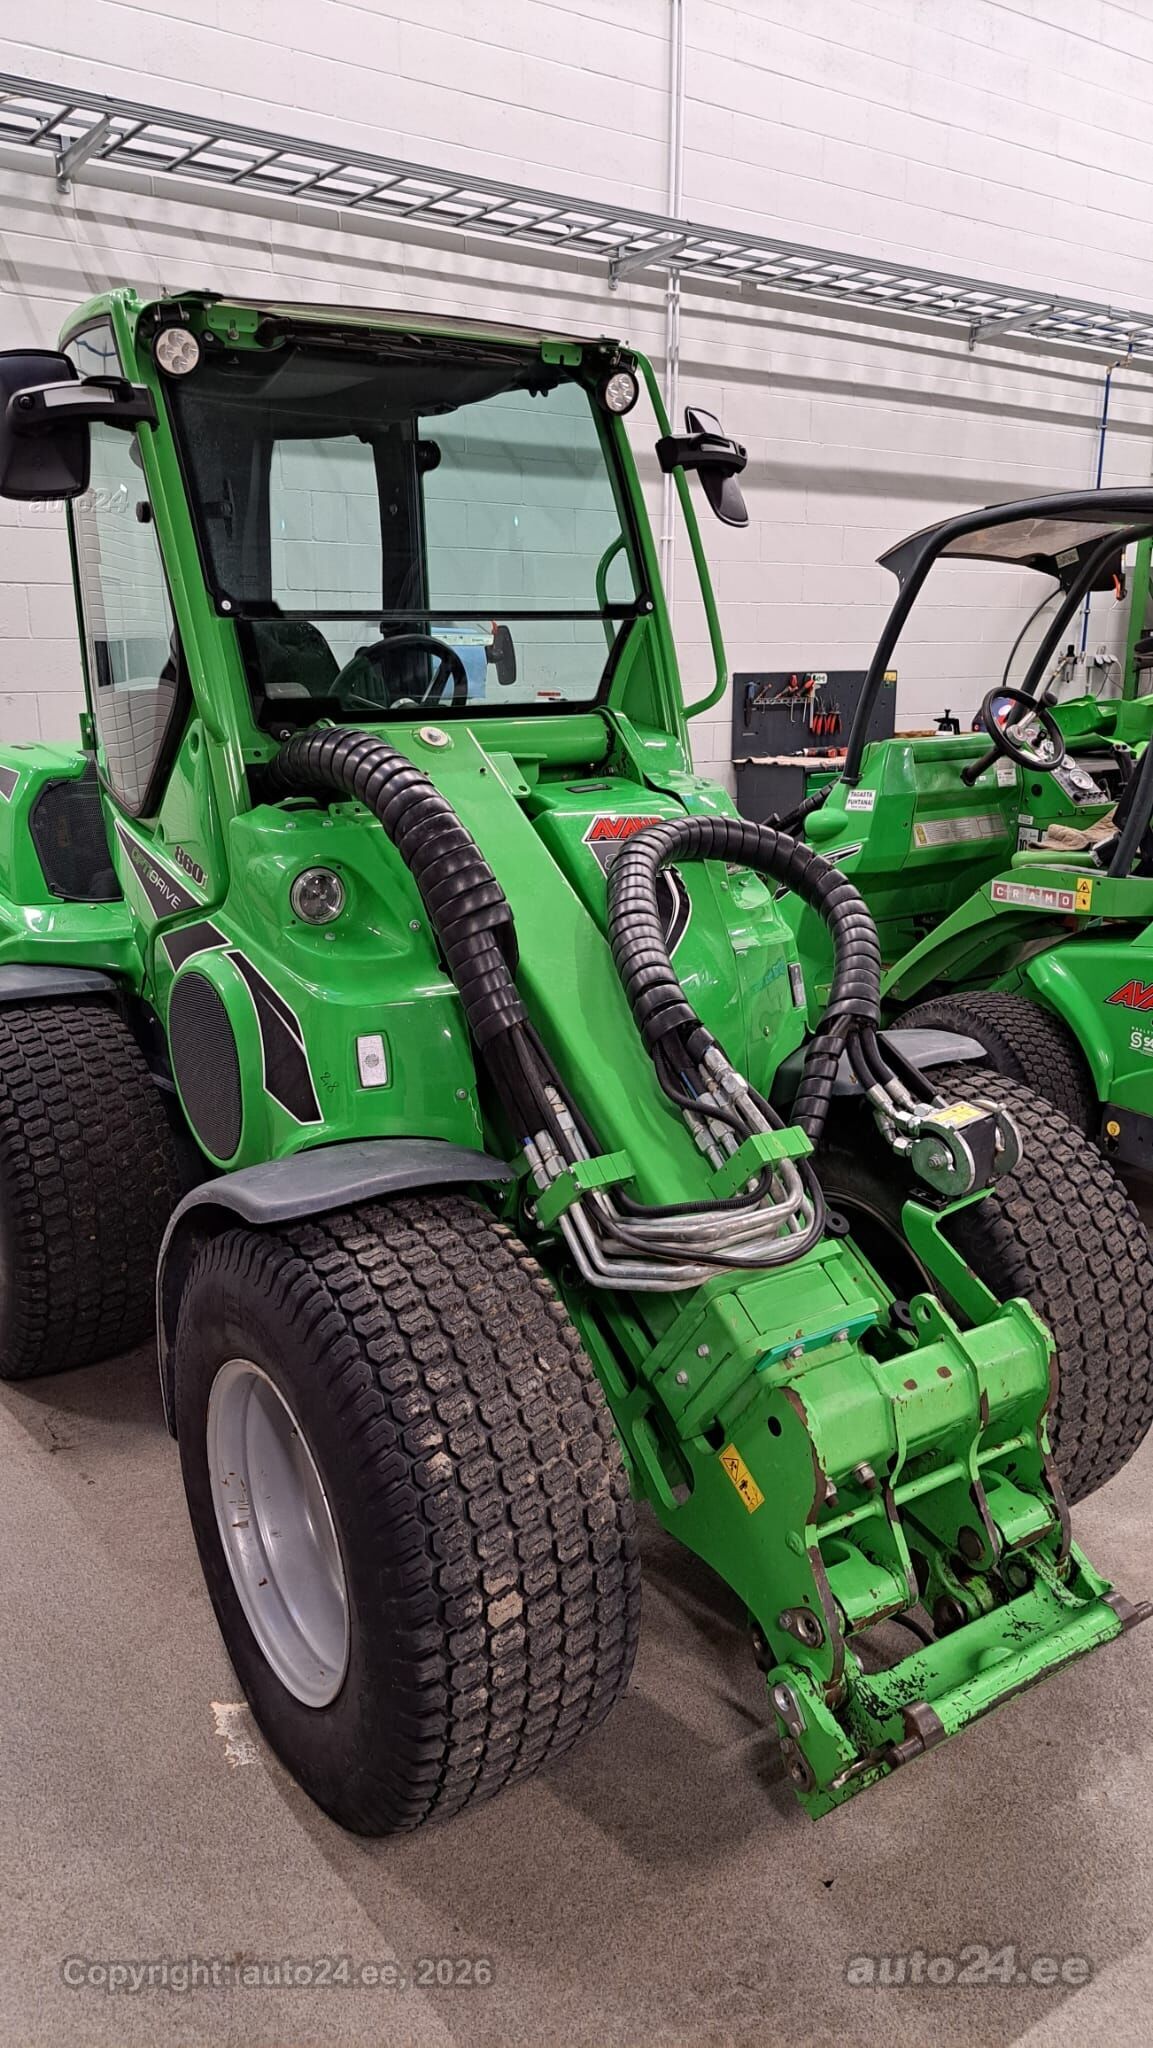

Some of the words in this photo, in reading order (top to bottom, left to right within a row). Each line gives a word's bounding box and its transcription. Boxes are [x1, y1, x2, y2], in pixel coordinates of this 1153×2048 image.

[587, 815, 662, 840] AVA
[996, 887, 1071, 905] CRAMO
[1104, 979, 1153, 1012] AV
